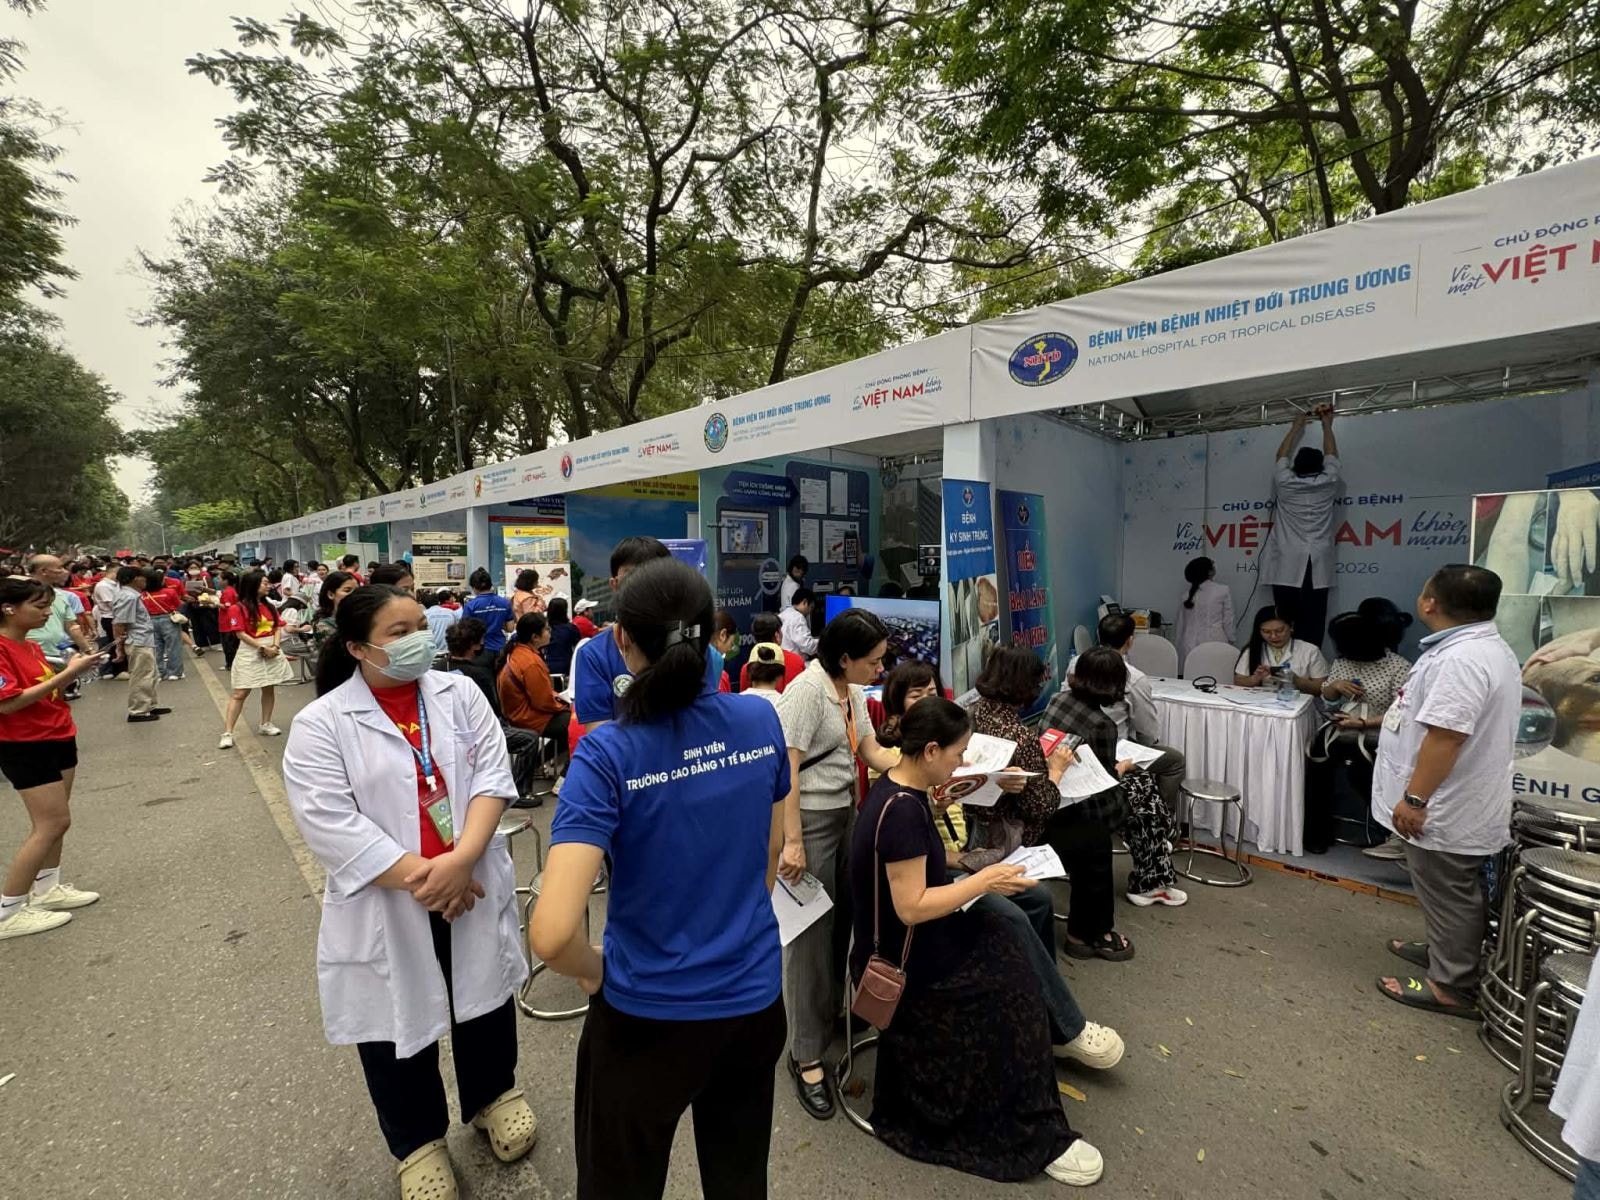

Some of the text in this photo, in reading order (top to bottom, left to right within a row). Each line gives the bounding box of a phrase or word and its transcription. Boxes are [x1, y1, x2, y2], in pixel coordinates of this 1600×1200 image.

[1494, 230, 1530, 248] CHỦ
[1535, 218, 1589, 239] ĐỘNG
[1452, 264, 1472, 283] Vì
[1481, 243, 1578, 285] VIỆT
[1448, 273, 1486, 296] một
[1088, 263, 1412, 349] BỆNH VIỆN BỆNH NHIỆT ĐỚI TRUNG ƯƠNG
[1088, 301, 1376, 368] NATIONAL HOSPITAL FOR TROPICAL DISEASES
[862, 382, 924, 409] VIỆT NAM
[657, 442, 672, 454] NAM
[1222, 499, 1251, 511] CHỦ
[1358, 493, 1404, 507] BỆNH
[961, 510, 977, 525] BỆNH
[958, 531, 971, 543] SINH
[1334, 518, 1402, 547] AM
[1335, 562, 1379, 575] 2026
[683, 741, 726, 761] SINH VIÊN
[626, 773, 669, 791] TRƯỜNG
[671, 766, 690, 781] CAO
[719, 757, 727, 769] Y
[727, 751, 740, 767] TẾ
[739, 747, 764, 764] BẠCH
[763, 743, 776, 757] MAI
[1511, 772, 1570, 799] ỆNH
